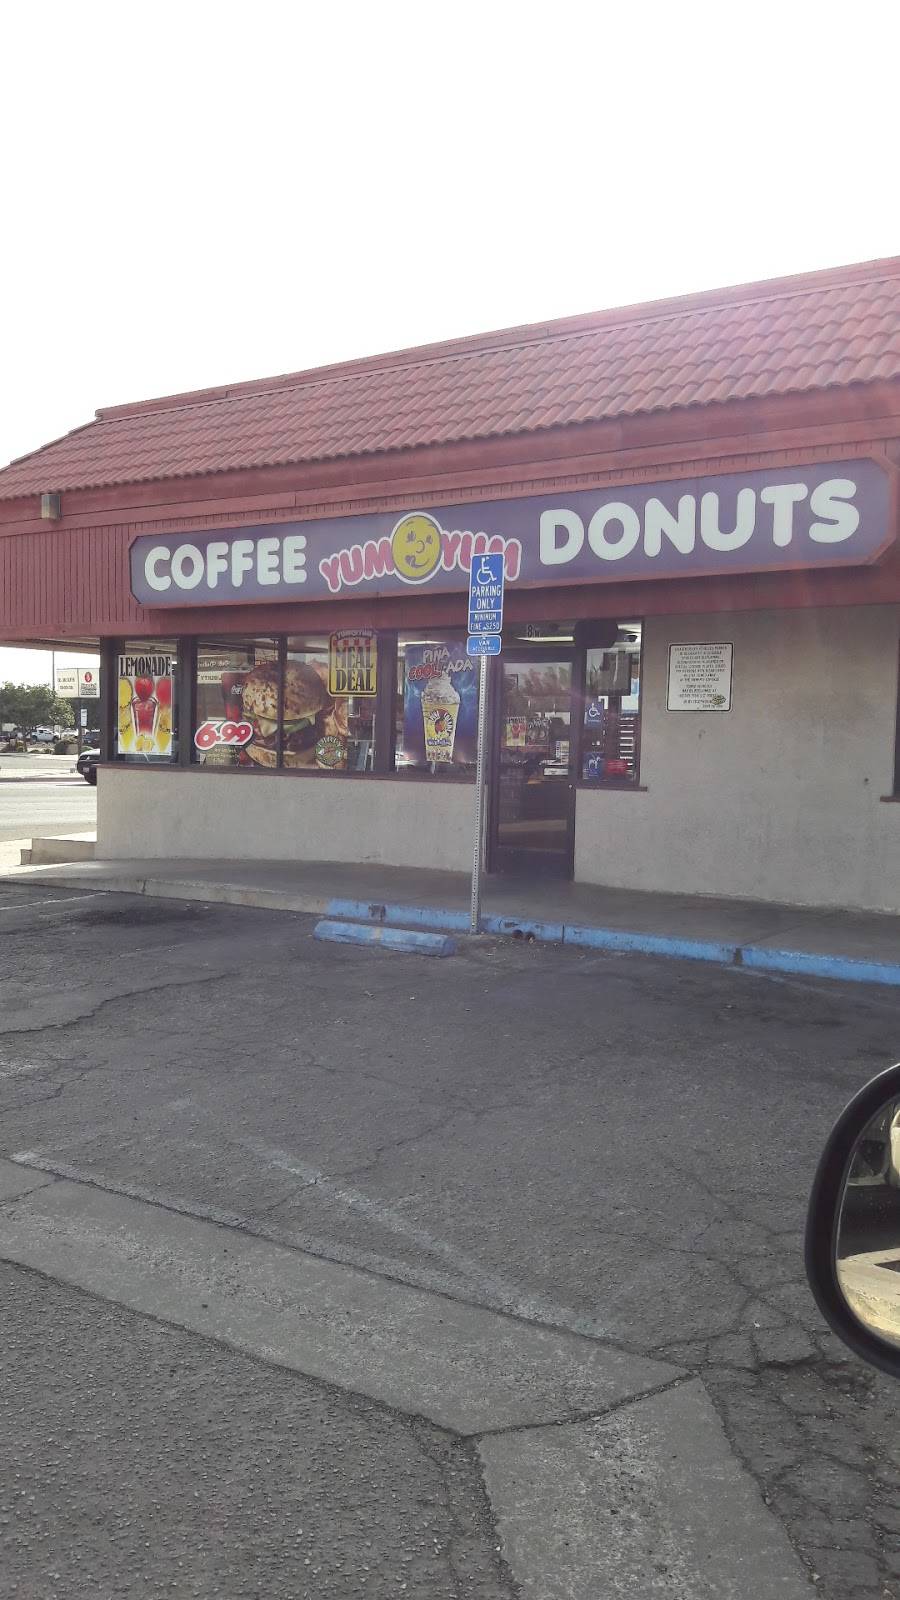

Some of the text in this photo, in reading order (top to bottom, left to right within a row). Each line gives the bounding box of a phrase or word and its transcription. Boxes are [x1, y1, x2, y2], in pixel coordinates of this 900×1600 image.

[144, 535, 308, 591] COFFEE
[319, 536, 398, 593] YUM
[539, 478, 860, 566] DONUTS
[471, 584, 502, 598] PARKING
[476, 598, 496, 610] ONLY
[470, 622, 483, 631] FINE
[119, 656, 171, 677] LEMONADE
[335, 669, 374, 691] DEAL
